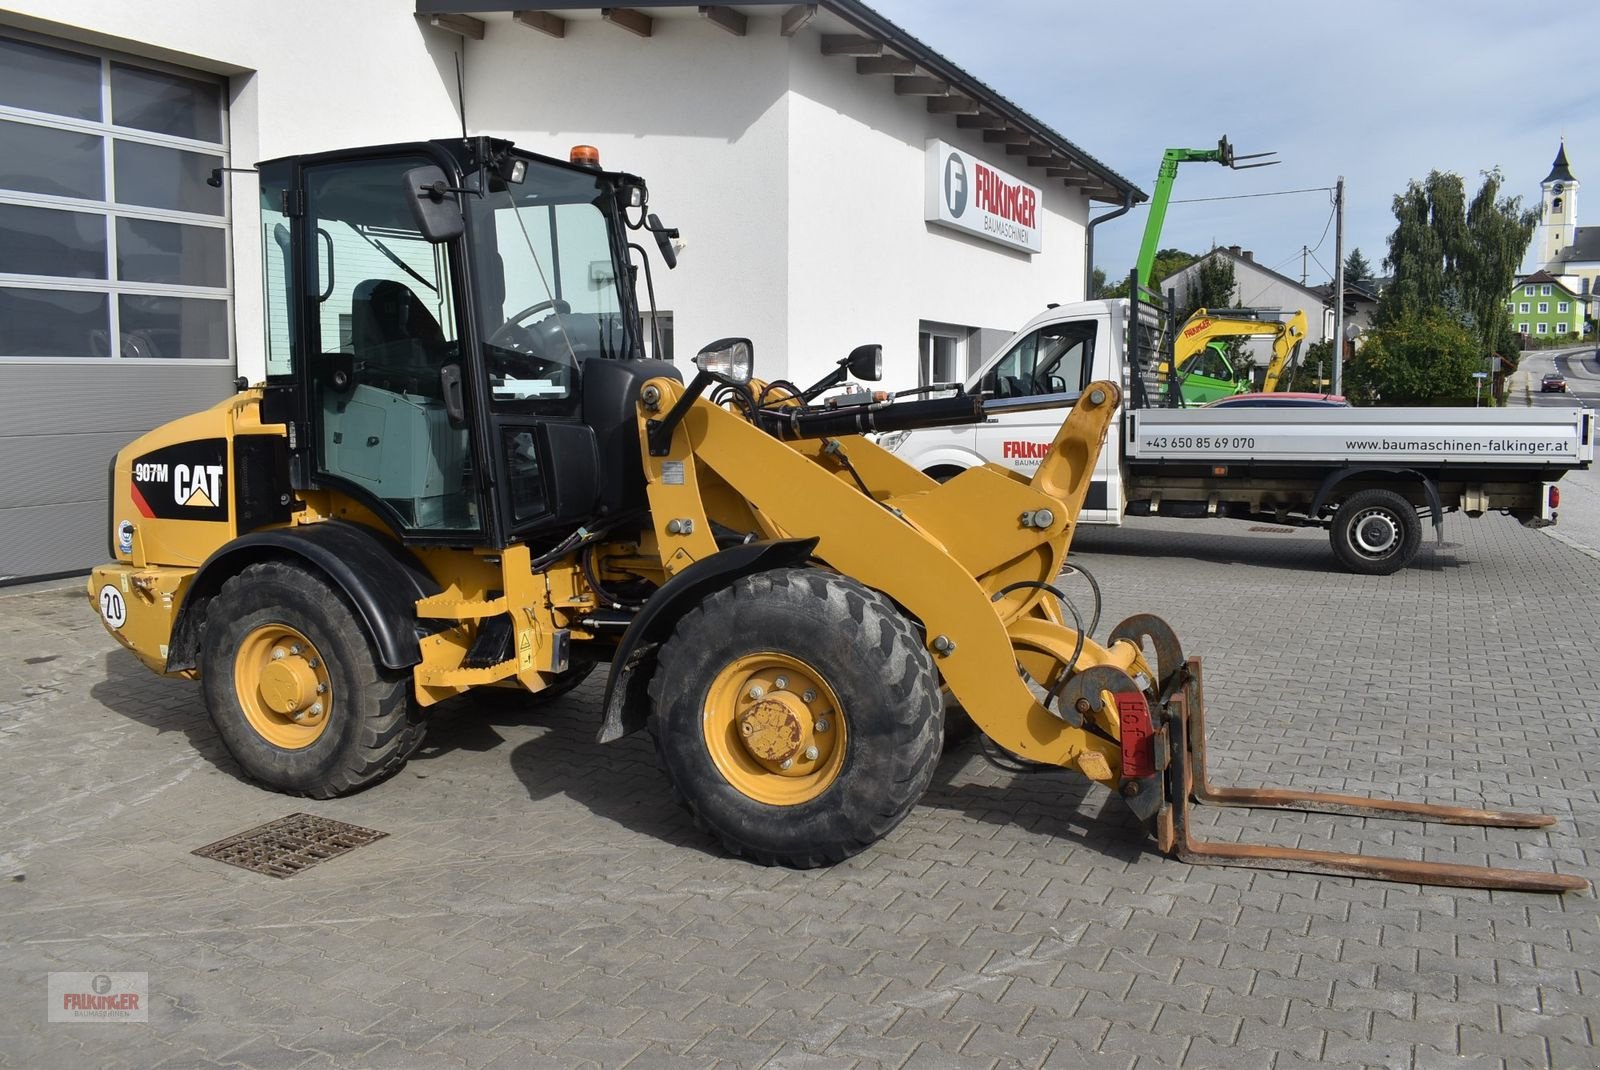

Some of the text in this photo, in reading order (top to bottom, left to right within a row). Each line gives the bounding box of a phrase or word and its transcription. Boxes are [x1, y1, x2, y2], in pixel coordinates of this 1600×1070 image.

[975, 163, 1036, 229] FALKINGER
[984, 215, 1029, 245] BAUMASCHINEN
[1146, 437, 1255, 449] +43 650 85 69 070
[1345, 439, 1568, 454] www.baumaschinen-falkinger.at
[136, 463, 169, 483] 907M
[174, 464, 223, 507] CAT
[104, 592, 122, 620] 20
